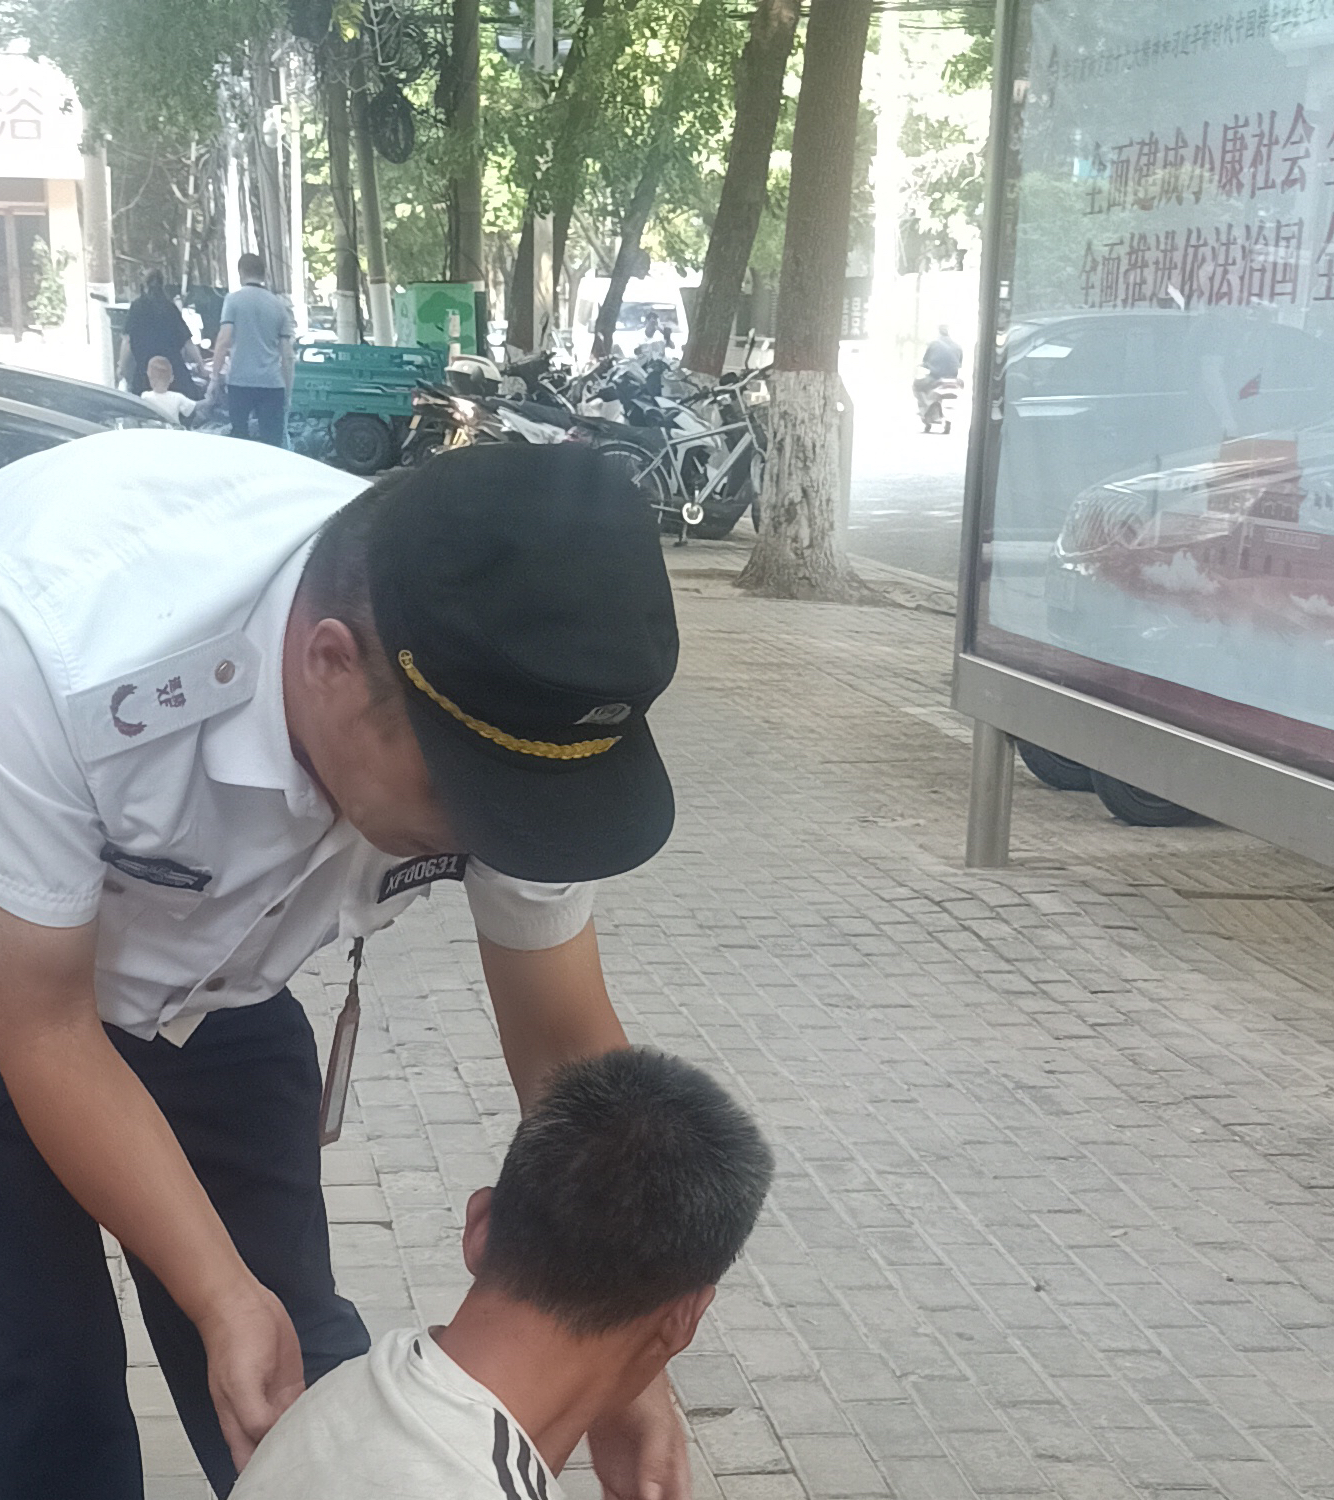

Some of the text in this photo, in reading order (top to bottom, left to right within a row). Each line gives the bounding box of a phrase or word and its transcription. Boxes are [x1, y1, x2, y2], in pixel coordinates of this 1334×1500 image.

[1083, 103, 1315, 215] 全面建成小康社会
[1080, 217, 1304, 309] 全面推进依法治国
[385, 855, 458, 894] XF00631
